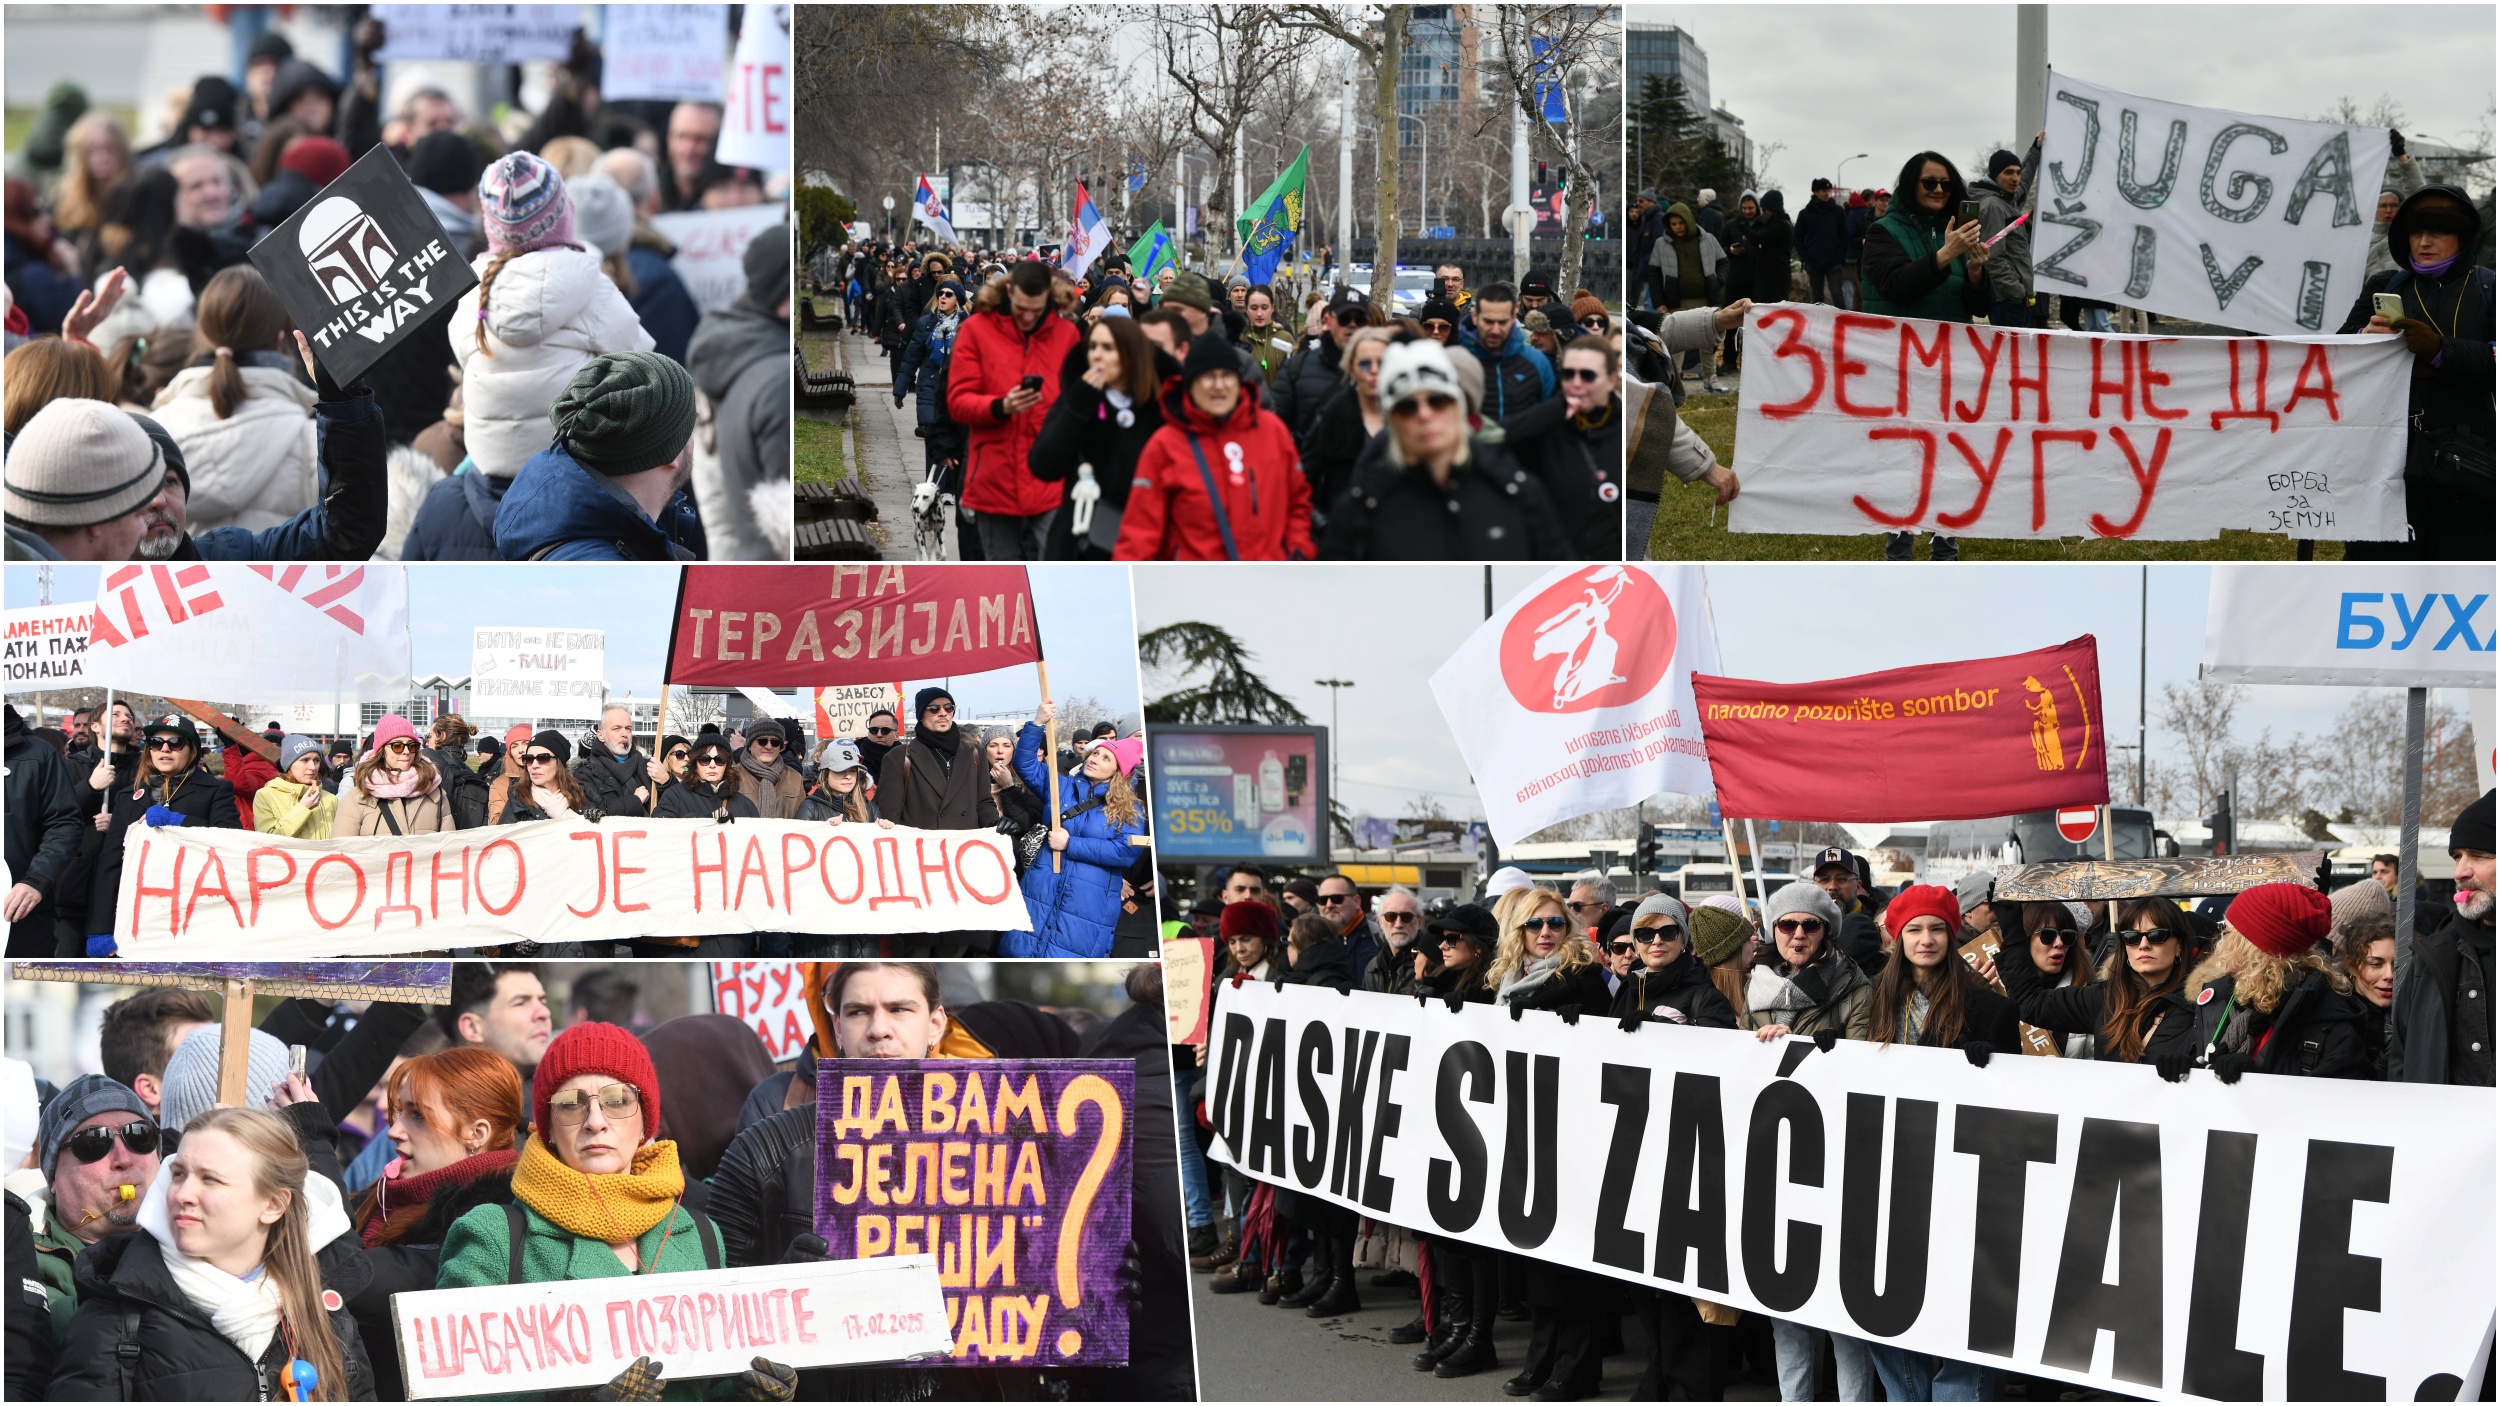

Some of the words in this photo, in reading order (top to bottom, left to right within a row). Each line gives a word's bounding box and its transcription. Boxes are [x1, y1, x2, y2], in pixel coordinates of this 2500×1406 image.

[2049, 90, 2362, 228] JUGA
[313, 300, 370, 348] THIS
[371, 280, 397, 306] IS
[398, 239, 448, 282] THE
[2033, 199, 2331, 330] ŽIVI
[356, 275, 434, 344] WAY
[1757, 309, 2051, 424] ЗЕМУН
[2089, 337, 2189, 421] НЕ
[2211, 341, 2341, 433] ДА
[1852, 426, 2173, 539] ЈУГУ
[2268, 511, 2335, 531] ЗЕМУН
[476, 632, 522, 649] БИТИ
[546, 632, 565, 648] НЕ
[567, 633, 605, 651] БИТИ
[689, 592, 1032, 662] ТЕРАЗИЈАМА
[477, 679, 544, 697] ПИТАЊЕ
[570, 681, 603, 699] САД
[836, 686, 886, 701] ЗАВЕСУ
[1708, 701, 1790, 720] narodno
[1793, 697, 1896, 723] pozorište
[1903, 687, 2000, 718] sombor
[838, 719, 854, 733] СУ
[842, 750, 854, 761] S
[1166, 780, 1192, 793] SVE
[1194, 784, 1208, 793] za
[1167, 796, 1197, 808] negu
[1199, 794, 1219, 806] lica
[1168, 808, 1234, 834] 35%
[132, 839, 528, 942] НАРОДНО
[566, 830, 651, 922] ЈЕ
[691, 832, 1013, 918] НАРОДНО
[833, 1074, 910, 1140] ДА
[921, 1071, 1049, 1134] ВАМ
[832, 1142, 1047, 1206] ЈЕЛЕНА
[1211, 1012, 1412, 1214] DASKE
[1426, 1039, 1561, 1251] SU
[1592, 1041, 2466, 1402] ZAĆUTALE.
[413, 1302, 593, 1380] ШАБАЧКО
[605, 1287, 819, 1364] ПОЗОРИШТЕ
